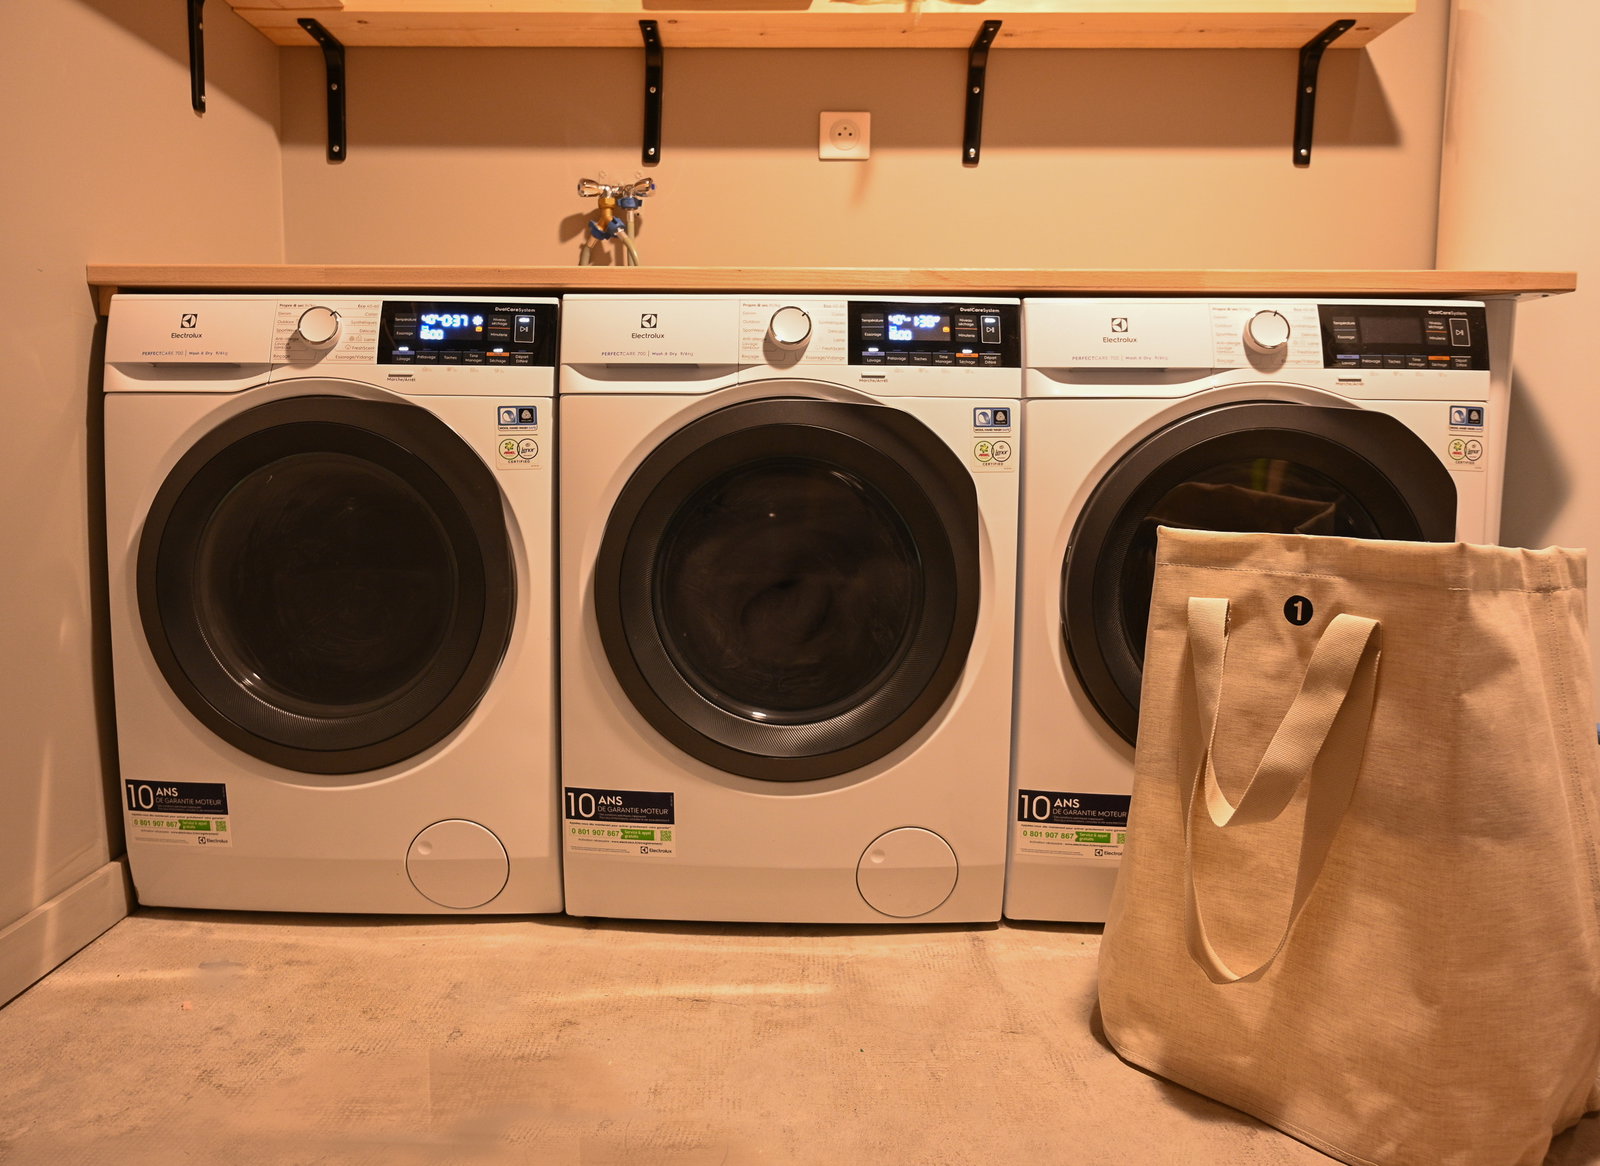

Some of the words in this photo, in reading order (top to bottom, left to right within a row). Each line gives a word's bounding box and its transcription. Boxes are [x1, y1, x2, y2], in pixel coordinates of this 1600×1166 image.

[1294, 600, 1303, 621] 1
[127, 784, 154, 809] 10
[156, 787, 178, 797] ANS
[166, 798, 195, 806] GARANTIE
[567, 792, 596, 818] 10
[598, 795, 623, 806] ANS
[607, 806, 639, 814] GARANTIE
[1021, 794, 1051, 821] 10
[1053, 798, 1080, 808] ANS
[1063, 809, 1096, 817] GARANTIE
[1097, 810, 1127, 818] MOTEUR
[1029, 830, 1042, 838] 801
[1060, 832, 1074, 840] 867
